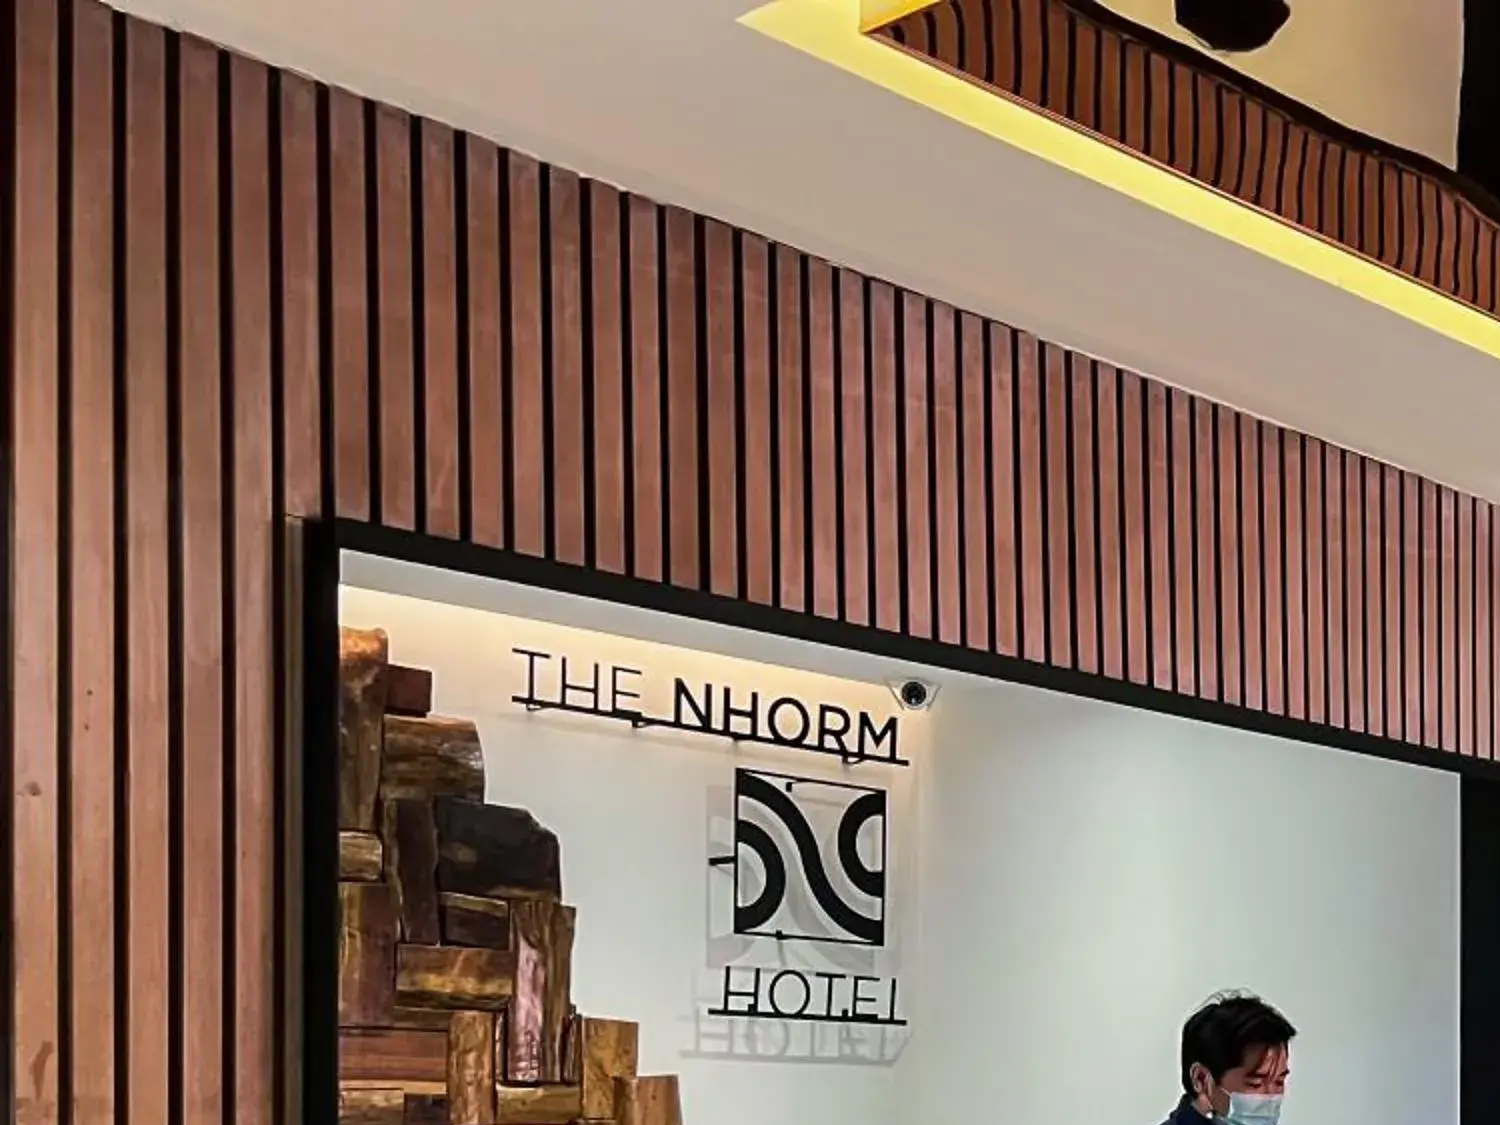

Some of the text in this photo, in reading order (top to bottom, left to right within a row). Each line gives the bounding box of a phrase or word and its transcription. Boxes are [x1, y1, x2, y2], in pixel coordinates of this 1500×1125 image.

[512, 647, 899, 762] THE NHORM
[724, 965, 904, 1023] HOTEL
